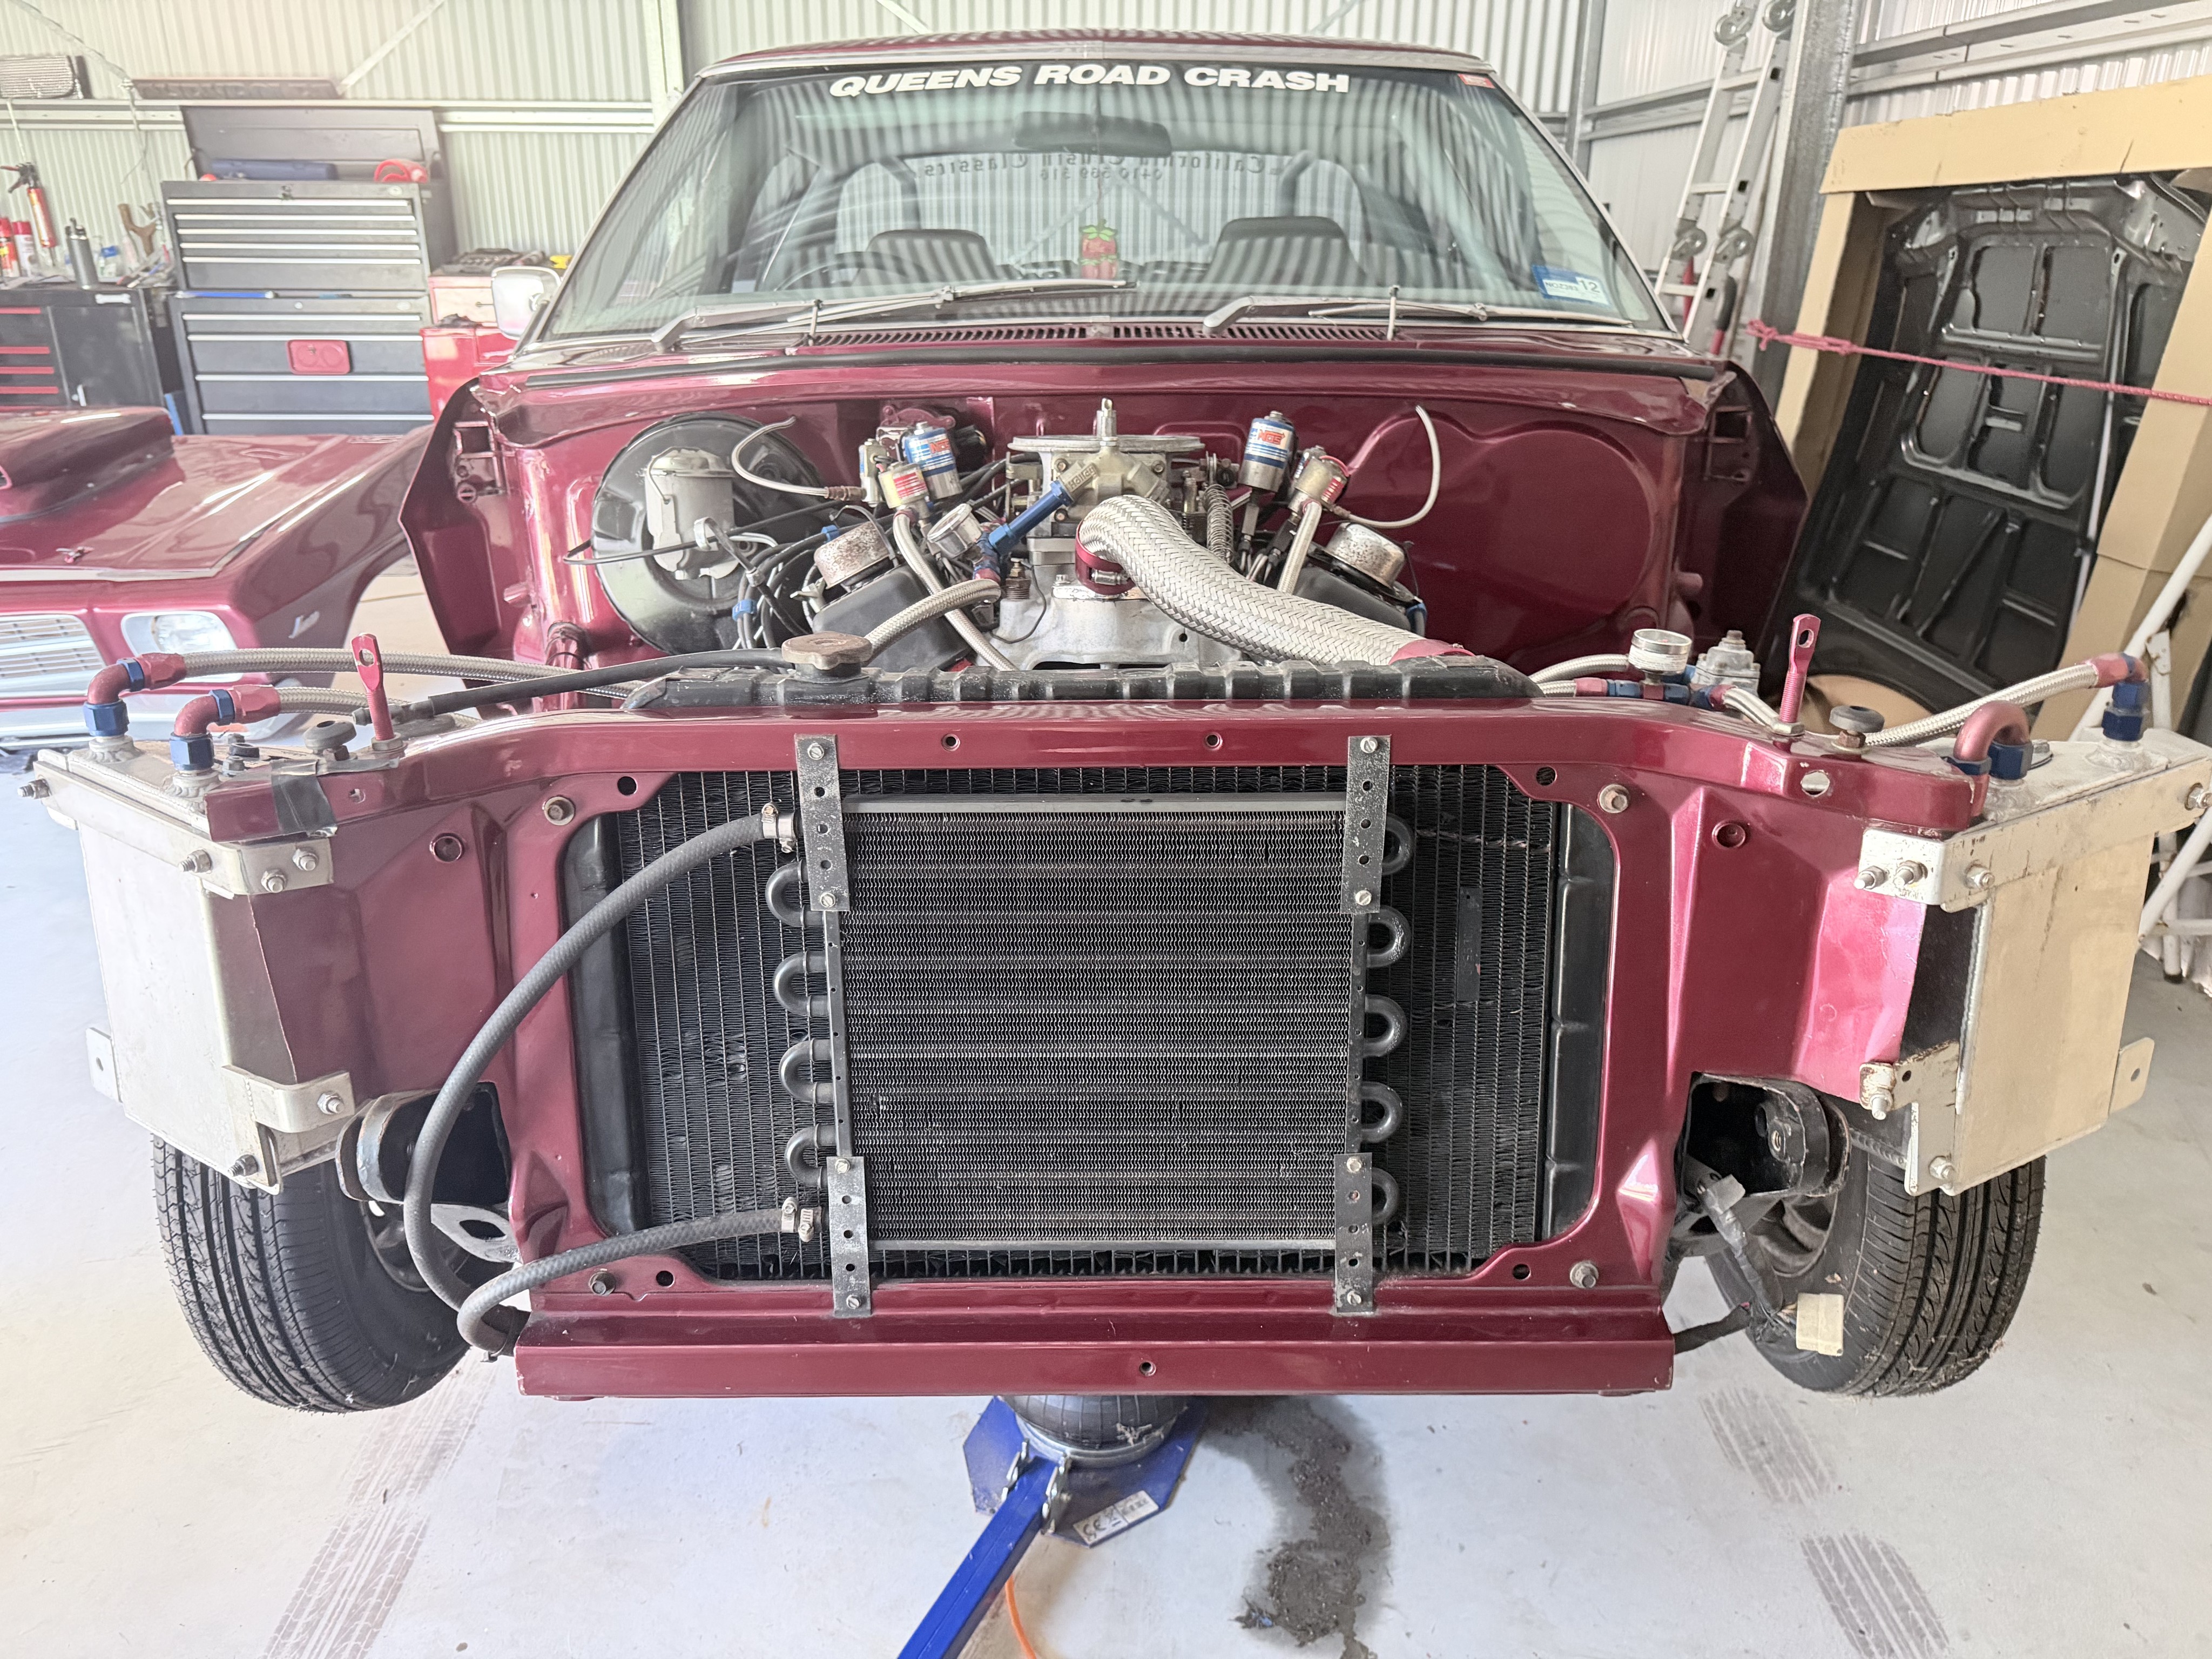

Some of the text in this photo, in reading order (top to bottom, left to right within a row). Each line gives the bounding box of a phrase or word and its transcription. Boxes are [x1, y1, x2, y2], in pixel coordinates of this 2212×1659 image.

[830, 64, 1349, 97] QUEENS ROAD CRASH
[1579, 279, 1600, 293] 12
[1257, 429, 1285, 445] NOS
